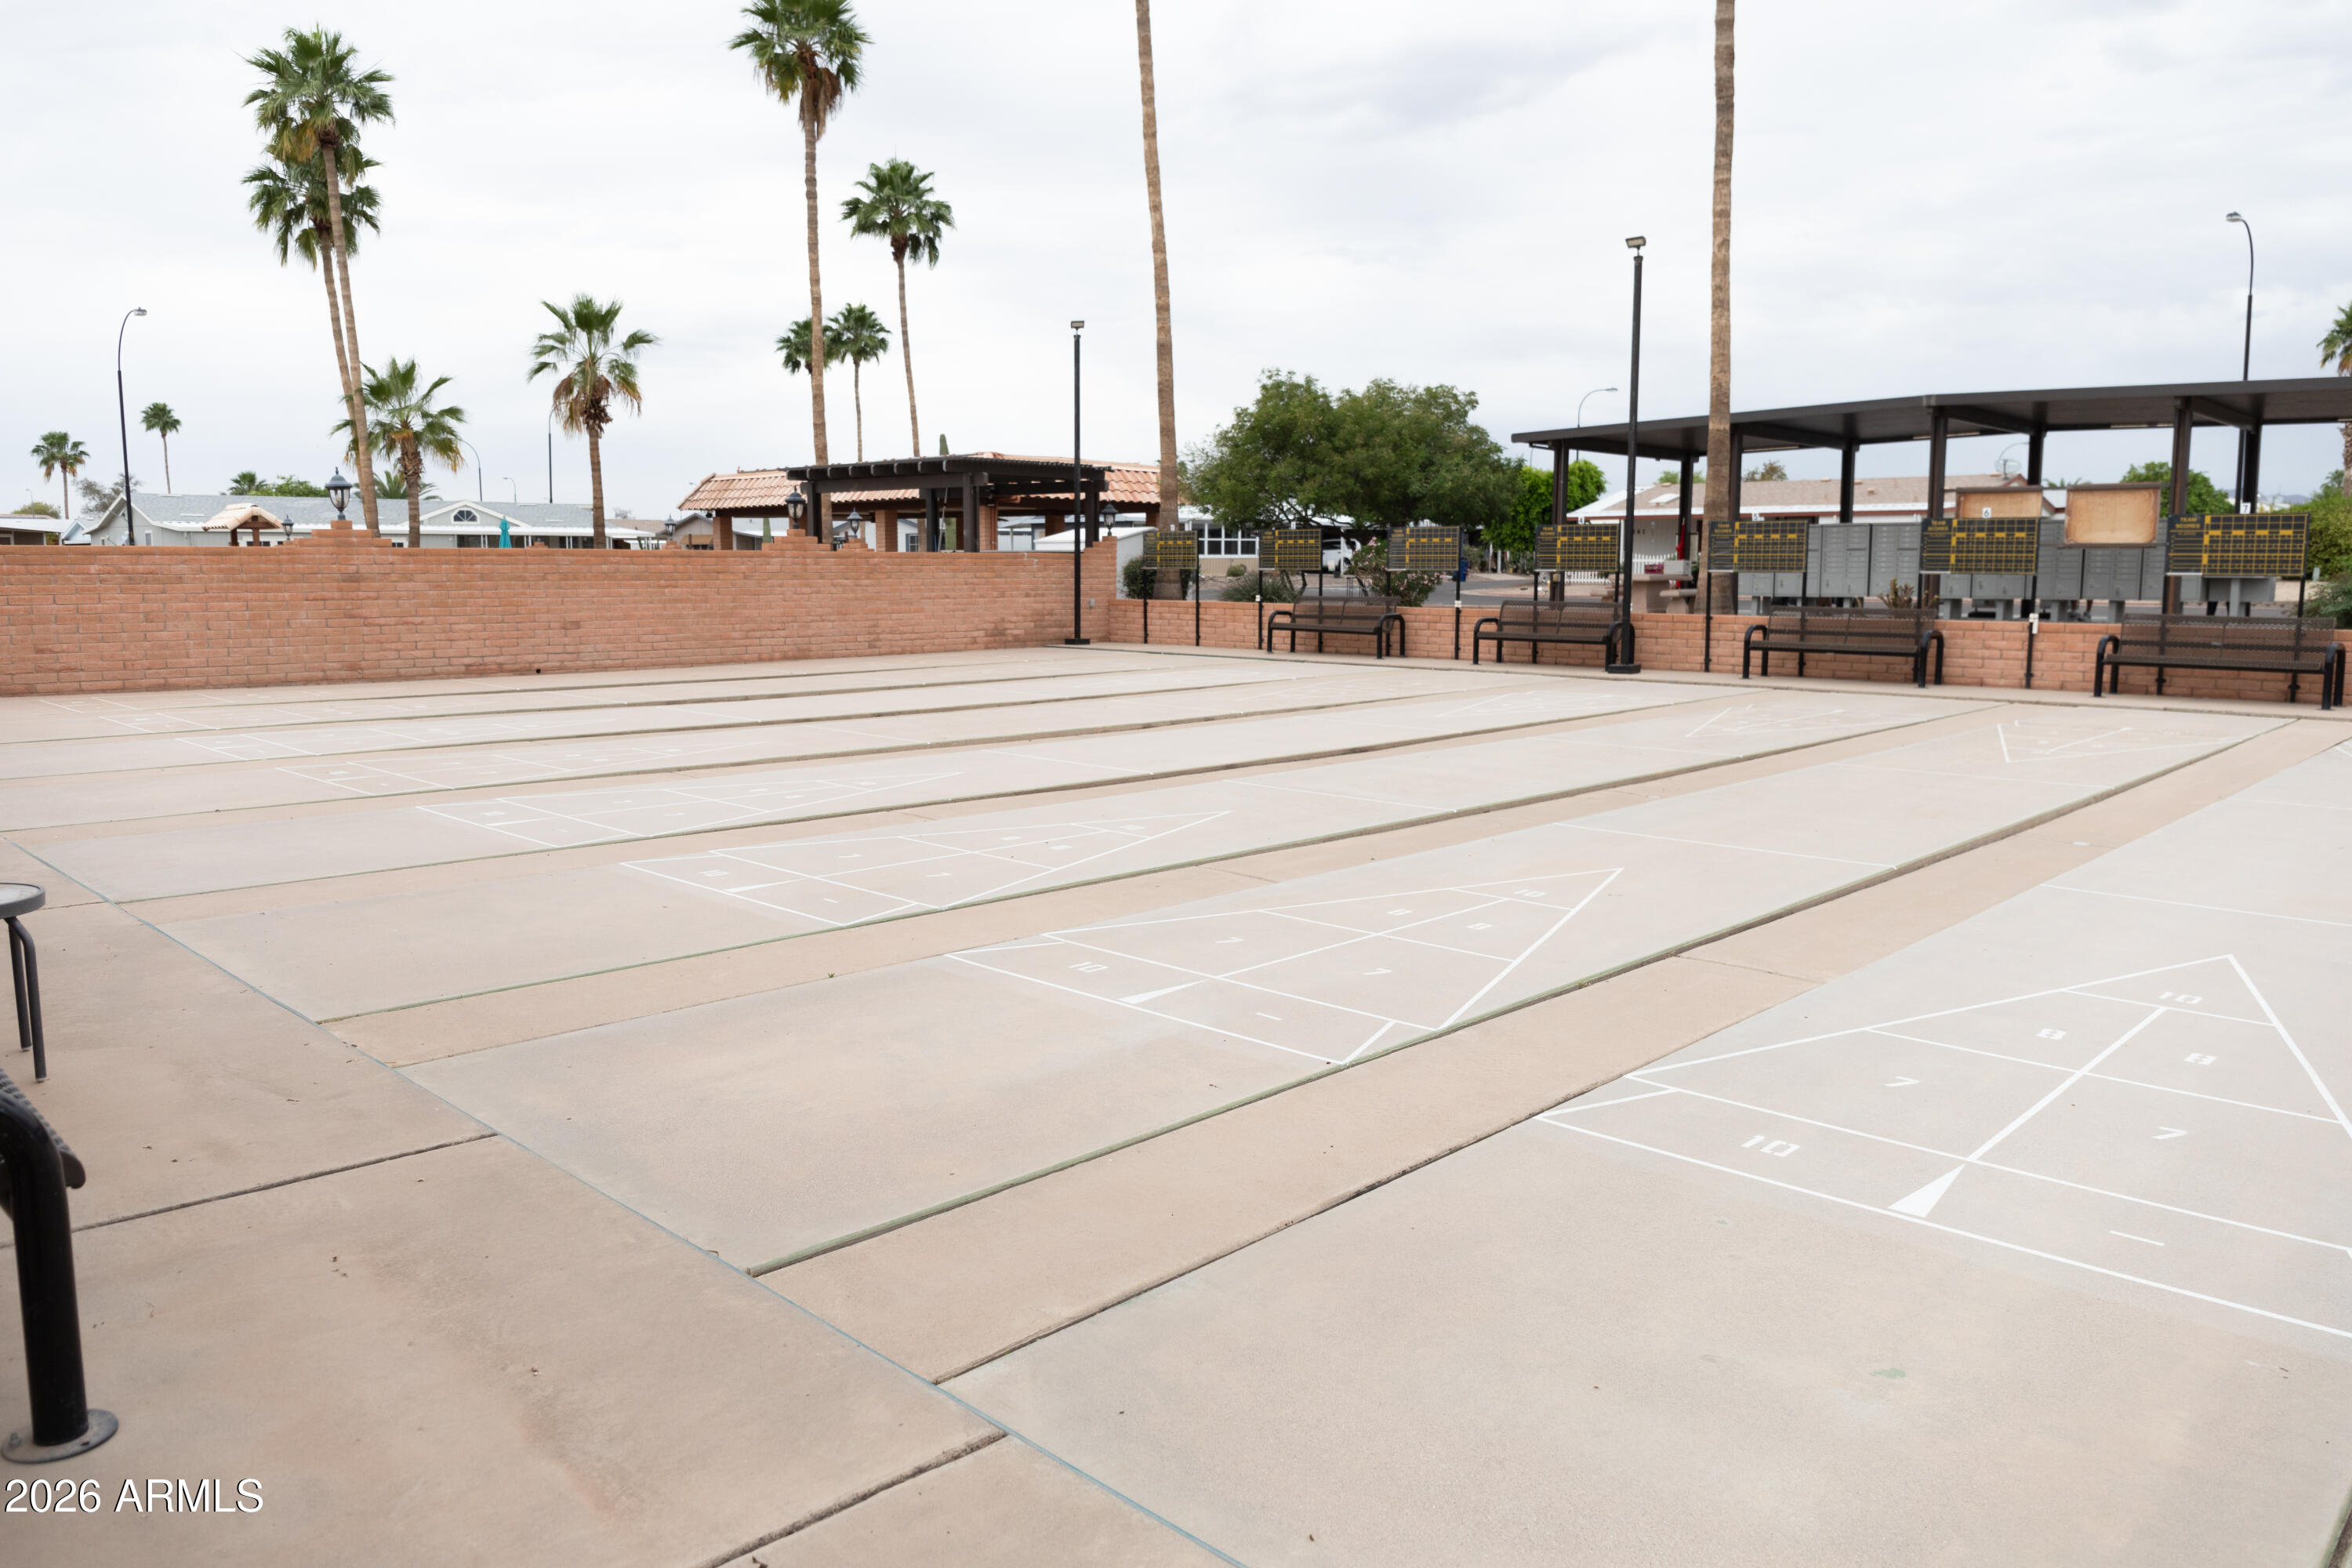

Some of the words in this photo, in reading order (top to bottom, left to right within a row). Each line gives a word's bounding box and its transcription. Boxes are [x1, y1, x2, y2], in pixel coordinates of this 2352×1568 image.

[1984, 509, 1990, 517] 6
[2242, 504, 2249, 513] 7
[1513, 889, 1548, 898] 10
[1069, 961, 1109, 973] 10
[2158, 991, 2204, 1004] 10
[2035, 1028, 2067, 1040] 8
[2183, 1052, 2218, 1065] 8
[1883, 1076, 1920, 1087] 7
[2151, 1126, 2188, 1140] 7
[1740, 1134, 1801, 1157] 10
